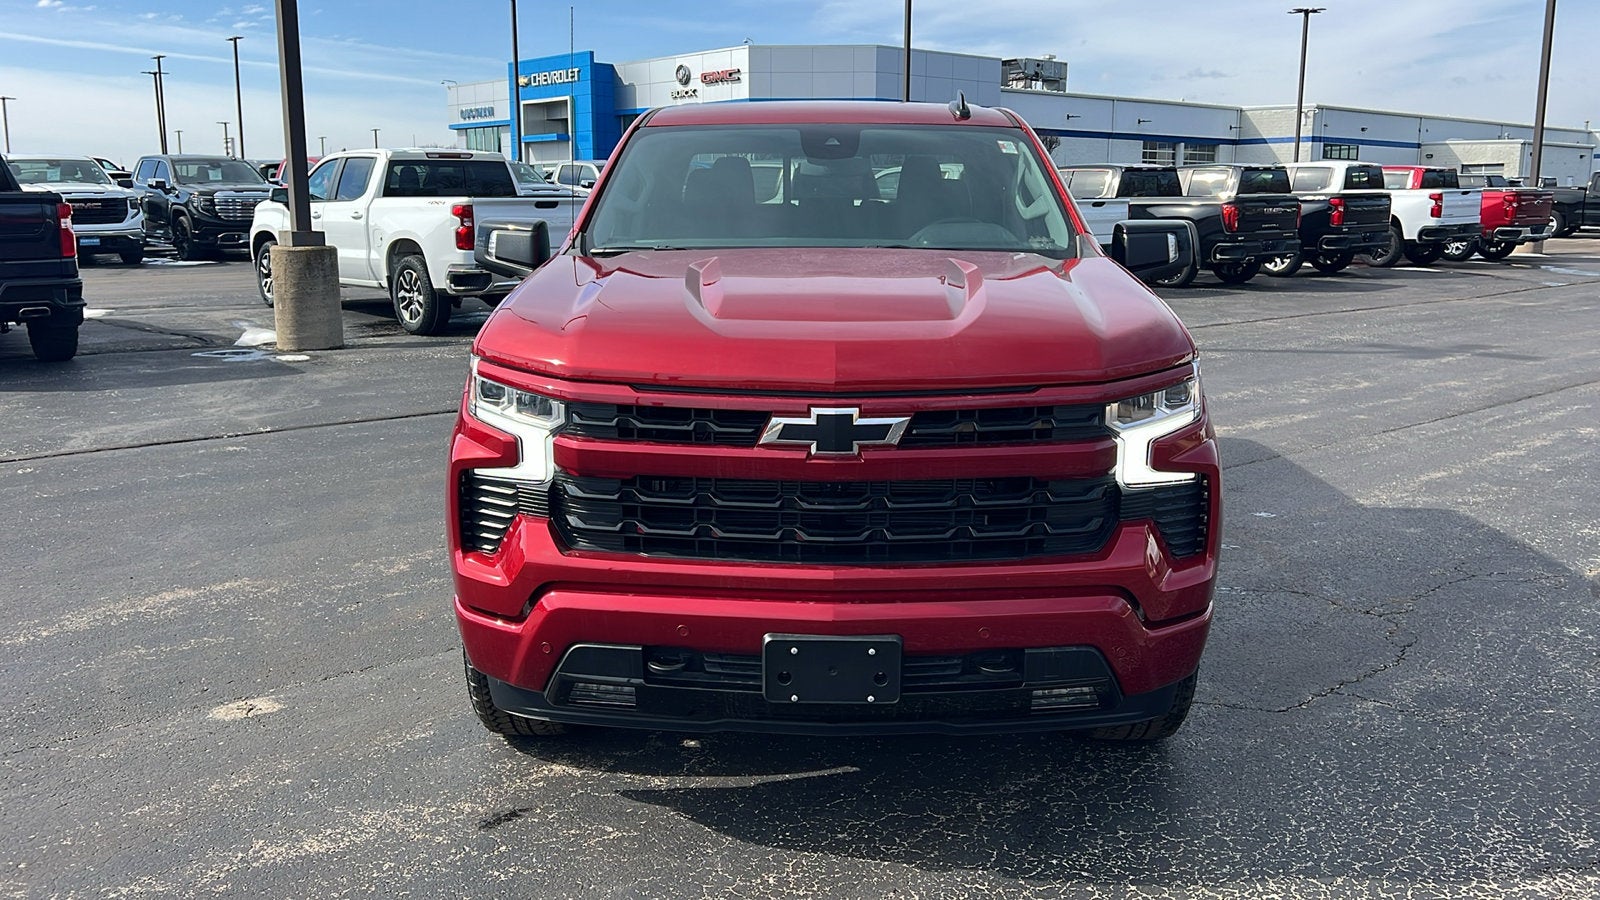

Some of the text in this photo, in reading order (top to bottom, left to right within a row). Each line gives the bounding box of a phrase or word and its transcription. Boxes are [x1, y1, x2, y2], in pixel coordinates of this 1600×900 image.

[531, 67, 580, 86] CHEVROLET
[701, 68, 741, 85] GMC
[671, 88, 698, 99] BUICK
